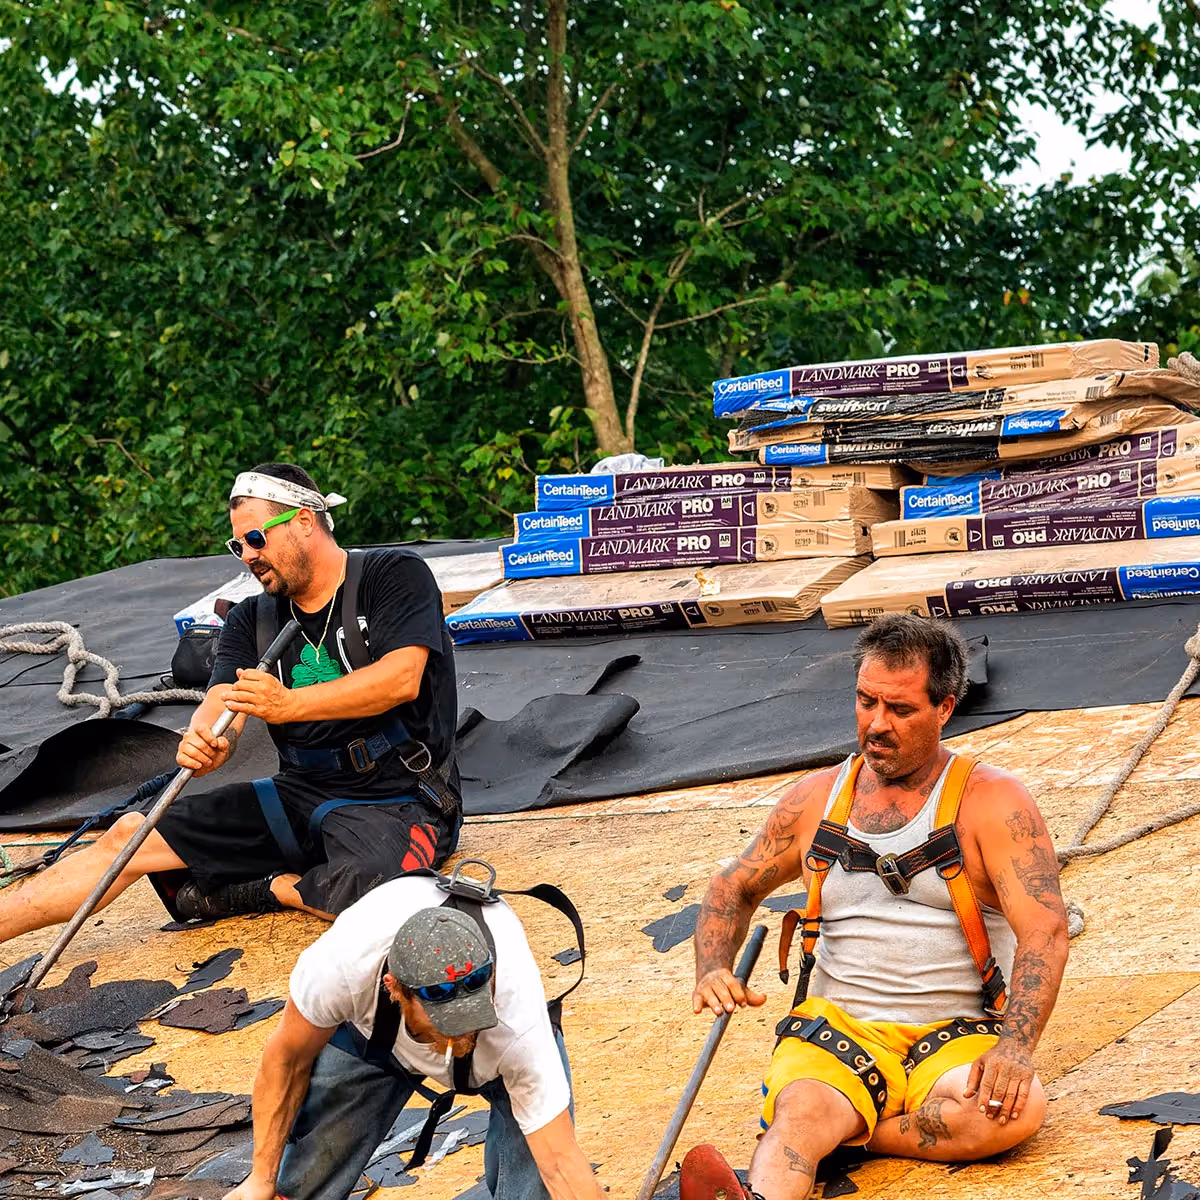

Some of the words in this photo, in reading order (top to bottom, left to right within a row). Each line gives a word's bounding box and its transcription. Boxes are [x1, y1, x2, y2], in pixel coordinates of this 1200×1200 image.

[798, 364, 881, 383] LANDMARK
[886, 363, 920, 377] PRO
[718, 376, 783, 394] CertainTeed
[816, 399, 891, 413] swiftstart
[770, 444, 820, 454] CertainTeed
[1098, 440, 1131, 457] PRO
[1140, 437, 1150, 445] AR
[543, 483, 607, 496] CertainTeed
[623, 476, 705, 491] LANDMARK
[712, 473, 746, 487] PRO
[988, 479, 1071, 499] LANDMARK
[1076, 472, 1112, 489] PRO
[908, 493, 973, 508] CertainTeed
[597, 502, 676, 521] LANDMARK
[682, 498, 714, 514] PRO
[522, 514, 583, 530] CertainTeed
[720, 534, 730, 542] AR
[1012, 529, 1047, 544] PRO
[1053, 525, 1137, 541] LANDMARK
[588, 538, 670, 557] LANDMARK
[677, 535, 712, 550] PRO
[508, 550, 574, 566] CertainTeed
[1020, 569, 1108, 585] LANDMARK
[1126, 567, 1199, 579] CertainTeed
[974, 577, 1012, 589] PRO
[530, 610, 614, 624] LANDMARK
[618, 606, 654, 618] PRO
[448, 618, 516, 631] CertainTeed
